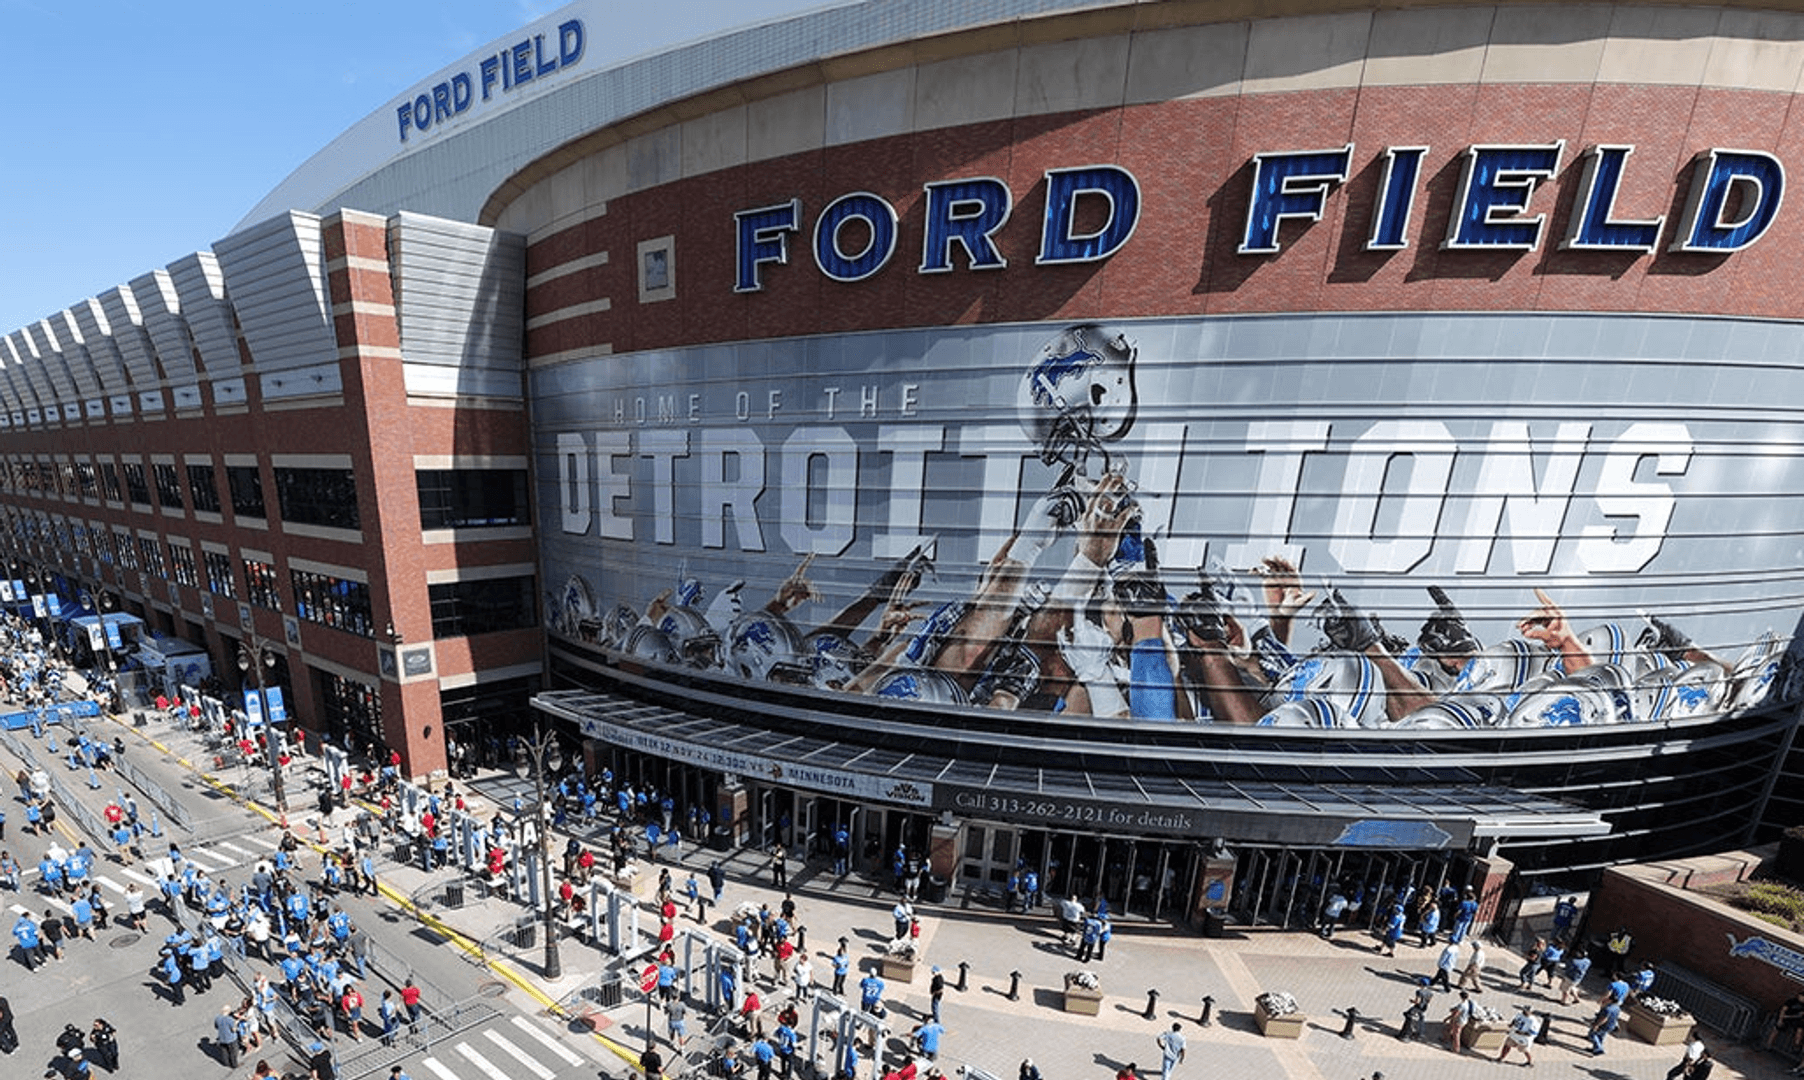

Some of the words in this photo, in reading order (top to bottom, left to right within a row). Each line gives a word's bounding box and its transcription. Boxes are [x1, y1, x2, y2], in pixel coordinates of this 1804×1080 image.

[396, 71, 473, 142] FORD
[479, 18, 585, 101] FIELD
[733, 163, 1142, 293] FORD
[1237, 139, 1786, 255] FIELD
[614, 393, 701, 425] HOME
[736, 390, 782, 421] OF
[824, 384, 918, 420] THE
[556, 424, 1046, 564] DETROIT
[1138, 420, 1696, 575] LIONS
[788, 768, 855, 789] MINNESOTA
[955, 792, 986, 809] Call
[989, 797, 1103, 821] 313-262-2121
[1108, 808, 1133, 824] for
[1137, 812, 1192, 830] details
